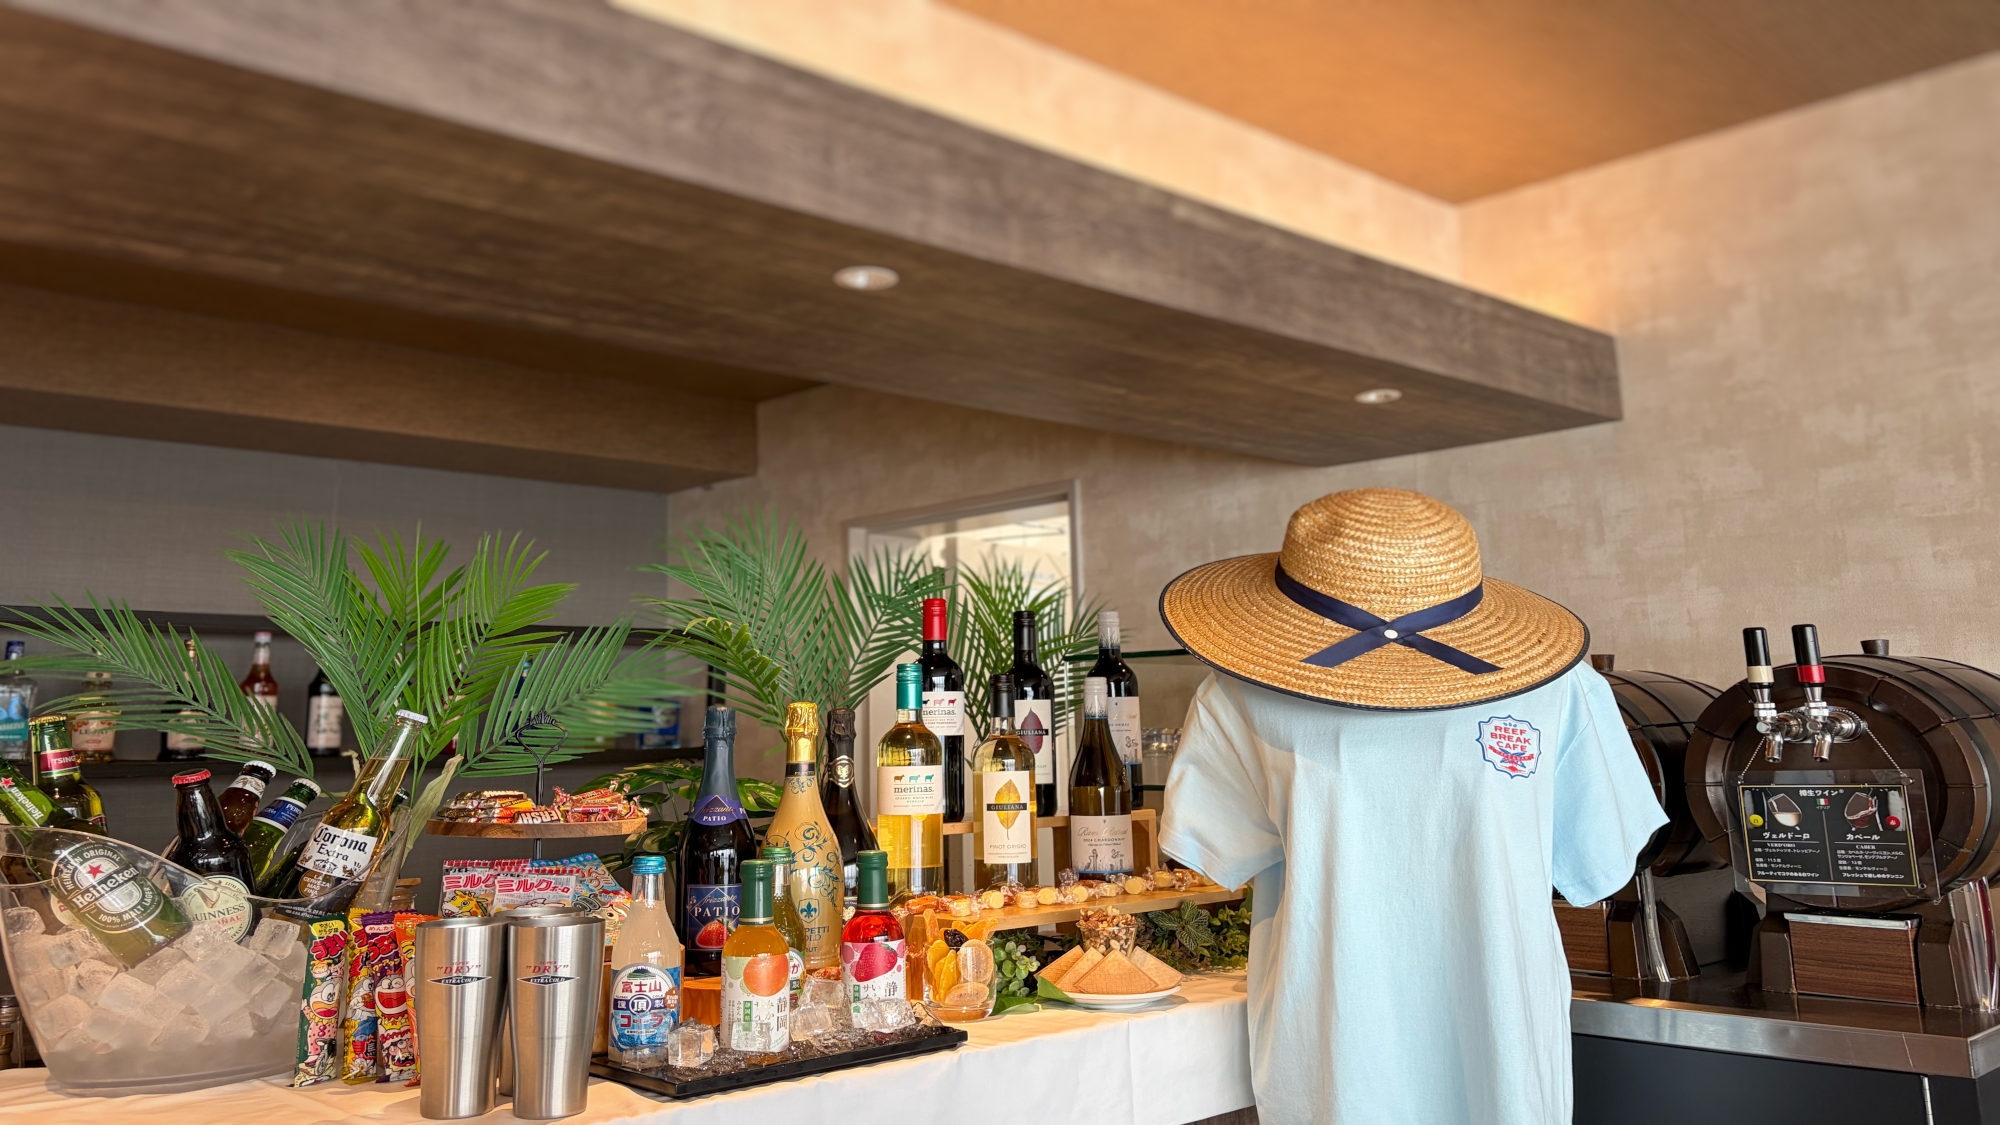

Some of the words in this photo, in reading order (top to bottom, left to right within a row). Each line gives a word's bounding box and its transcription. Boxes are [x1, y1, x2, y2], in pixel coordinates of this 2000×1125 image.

[1494, 726, 1527, 736] REEF
[1490, 732, 1532, 745] BREAK
[1496, 741, 1528, 752] CAFE
[313, 825, 368, 853] Corona
[83, 849, 121, 862] ORIGINAL
[317, 843, 349, 861] Extra
[72, 866, 140, 909] Heineken
[99, 913, 121, 923] 100%
[123, 905, 145, 921] MALT
[142, 886, 153, 906] LAGER
[694, 905, 741, 917] PATIO
[310, 930, 348, 960] うまい
[622, 980, 662, 993] 富士山
